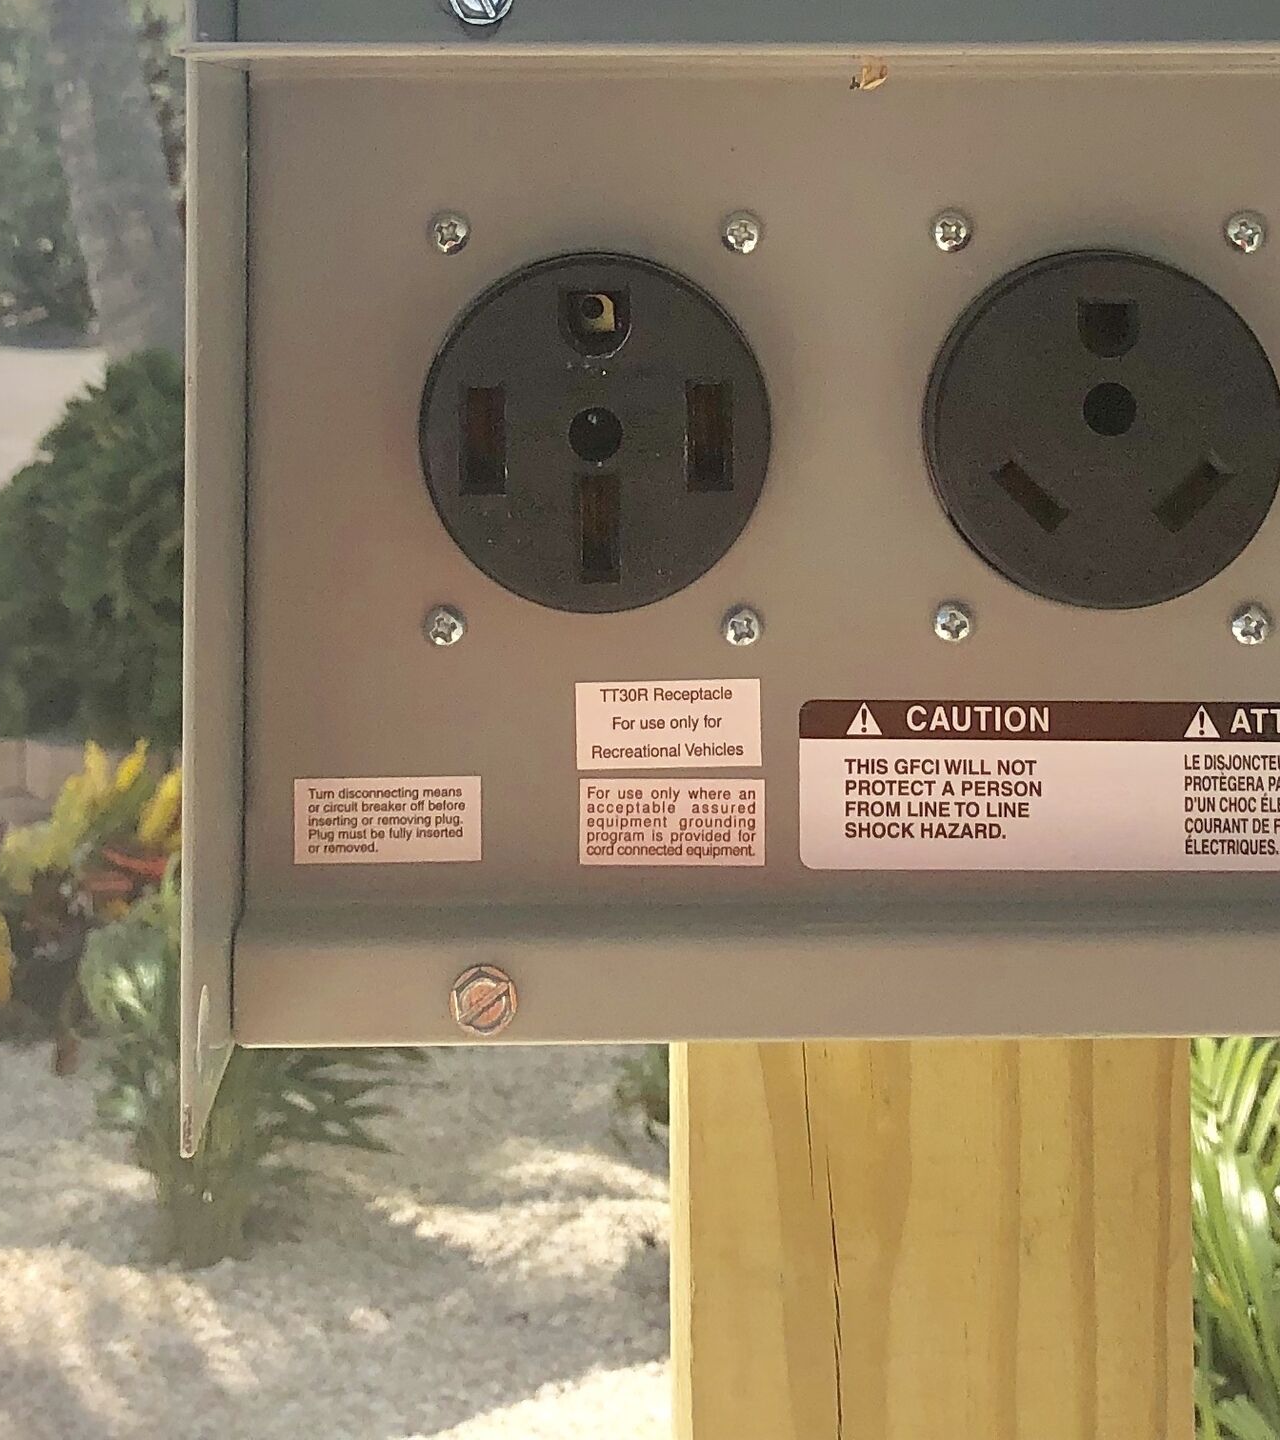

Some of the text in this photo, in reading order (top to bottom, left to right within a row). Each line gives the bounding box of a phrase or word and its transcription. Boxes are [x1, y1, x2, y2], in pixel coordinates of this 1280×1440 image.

[600, 687, 732, 703] TT30R Receptacle
[612, 715, 722, 731] For use only for
[906, 705, 1050, 732] CAUTION
[592, 743, 744, 759] Recreational Vehicles
[845, 759, 1037, 775] THIS GFCI WILL NOT
[1184, 754, 1200, 770] LE
[845, 780, 1042, 797] PROTECT A PERSON
[1184, 772, 1264, 791] PROTÈGERA
[308, 788, 462, 800] Turn disconnecting means
[587, 786, 756, 802] For use only where an
[308, 800, 465, 812] or circuit breaker off before
[587, 802, 756, 815] acceptable assured
[845, 801, 1030, 818] FROM LINE TO LINE
[1184, 797, 1215, 813] D'UN
[1219, 797, 1257, 813] CHOC
[308, 814, 463, 828] inserting or removing plug.
[587, 816, 756, 830] equipment grounding
[1184, 818, 1248, 834] COURANT
[1252, 818, 1269, 834] DE
[308, 827, 463, 841] Plug must be fully inserted
[587, 830, 756, 844] program is provided for
[845, 822, 1007, 839] SHOCK HAZARD.
[308, 842, 378, 853] or removed.
[586, 844, 756, 858] cord connected equipment.
[1184, 835, 1279, 855] ÉLECTRIQUES.
